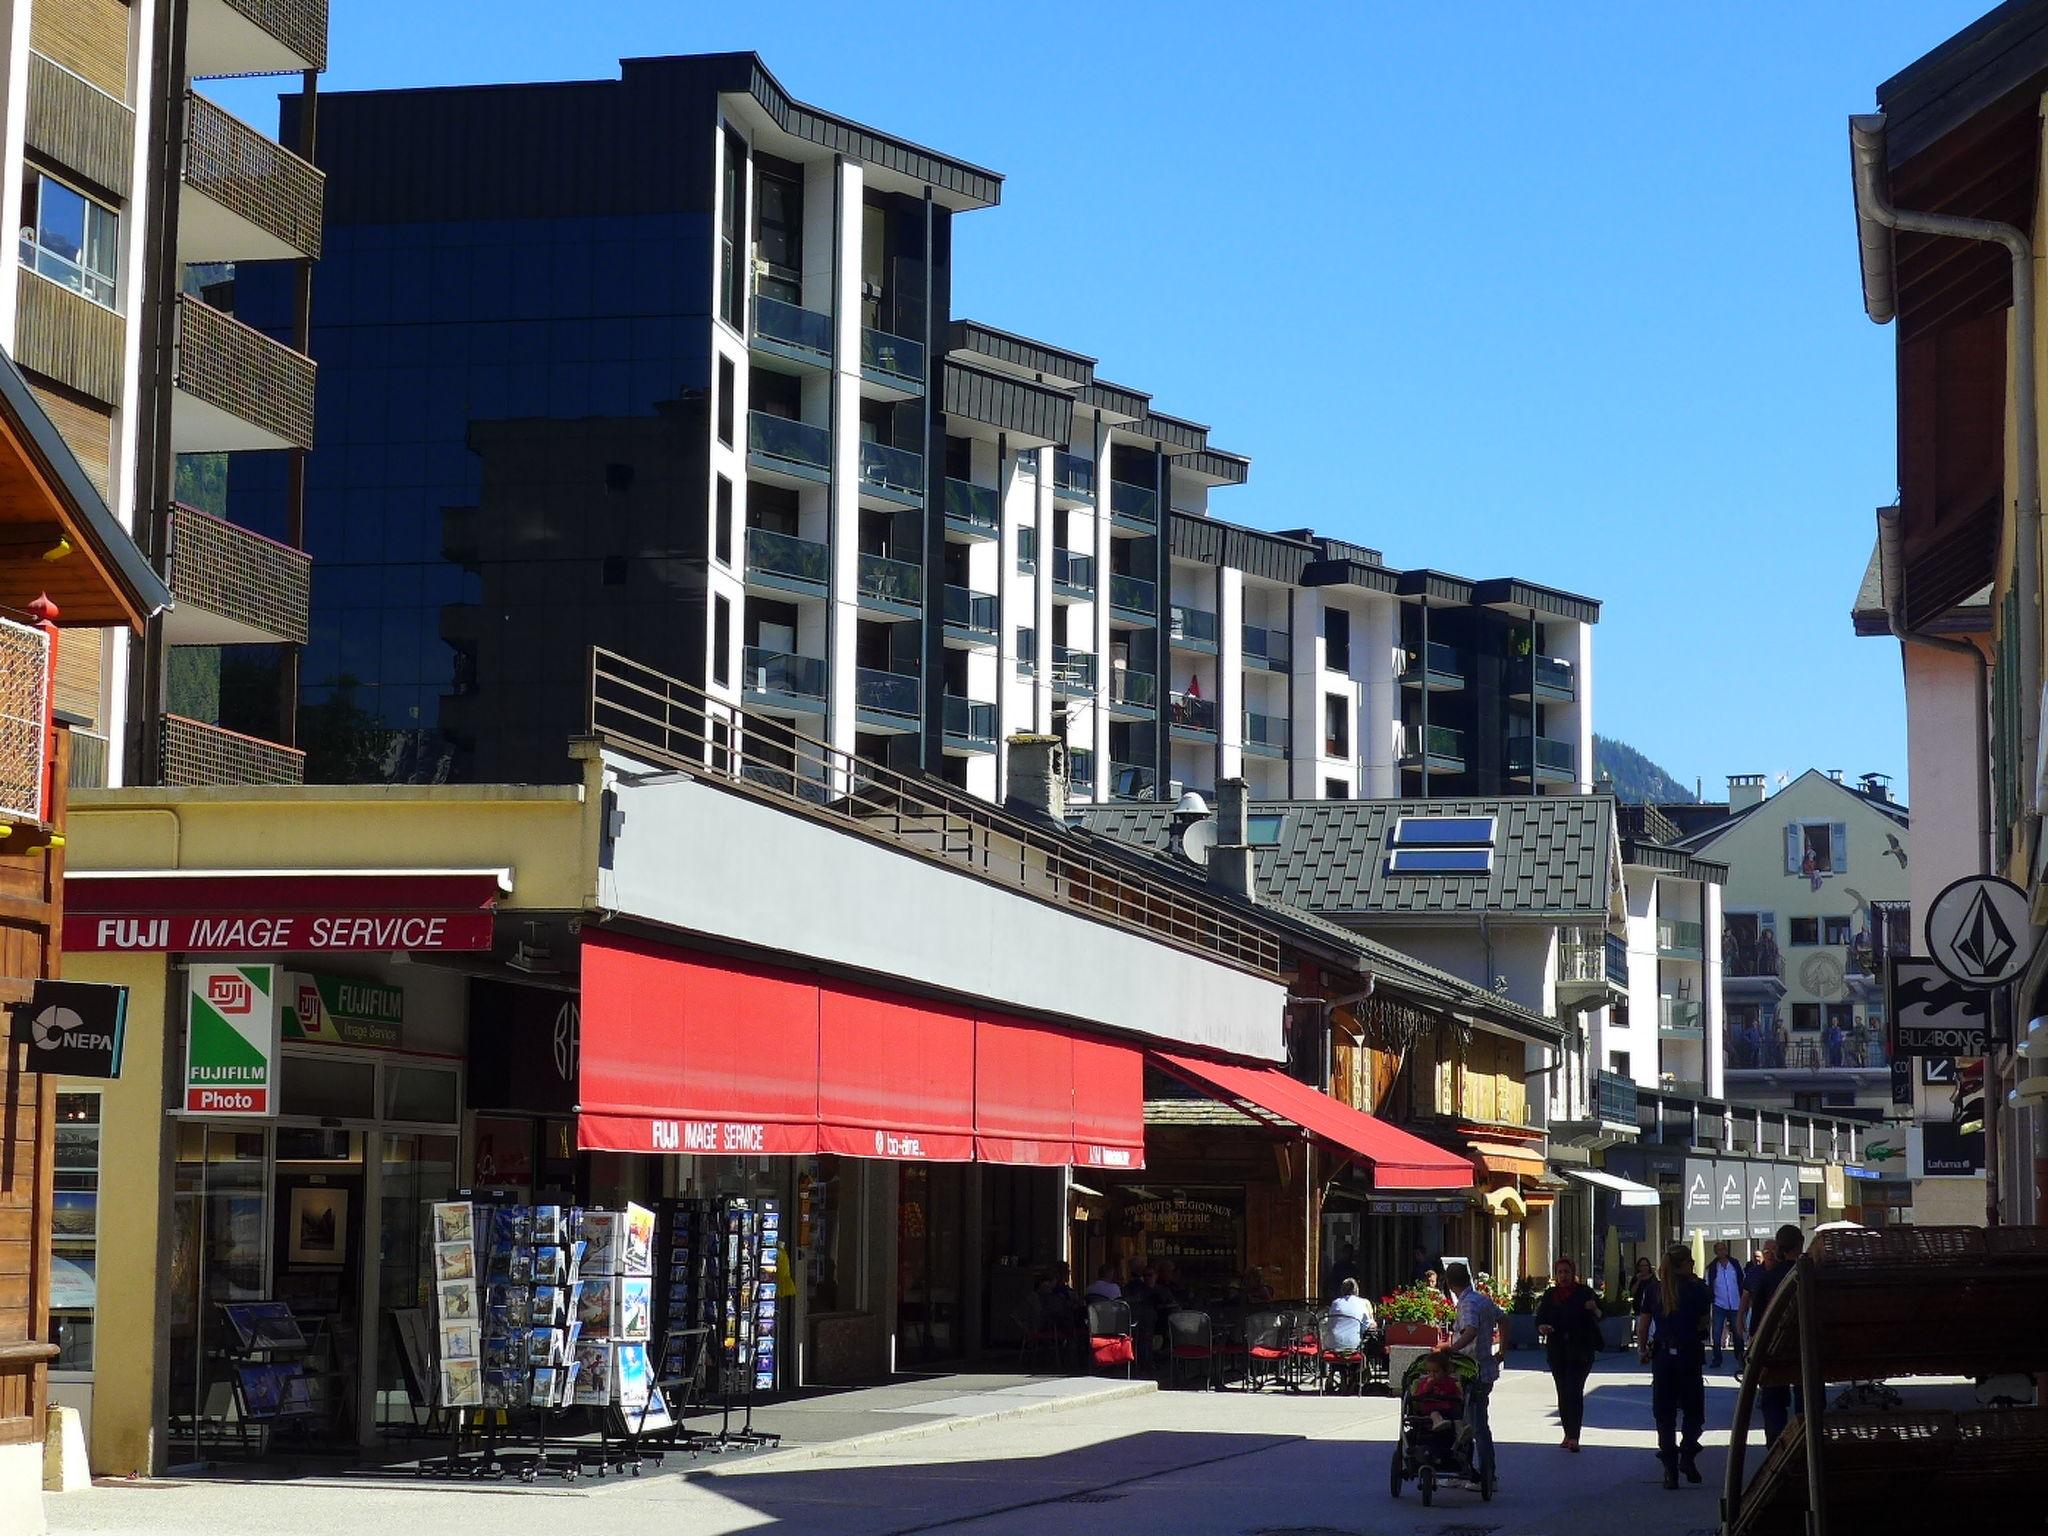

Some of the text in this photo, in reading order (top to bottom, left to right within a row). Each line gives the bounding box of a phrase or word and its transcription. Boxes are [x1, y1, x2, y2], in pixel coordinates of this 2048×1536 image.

[97, 918, 447, 947] FUJI IMAGE SERVICE
[338, 985, 401, 1018] FUJIFILM
[344, 1022, 398, 1041] Image Service
[190, 1065, 264, 1080] FUJIFILM
[200, 1091, 253, 1109] Photo
[651, 1120, 764, 1151] FUJI IMAGE SERVICE
